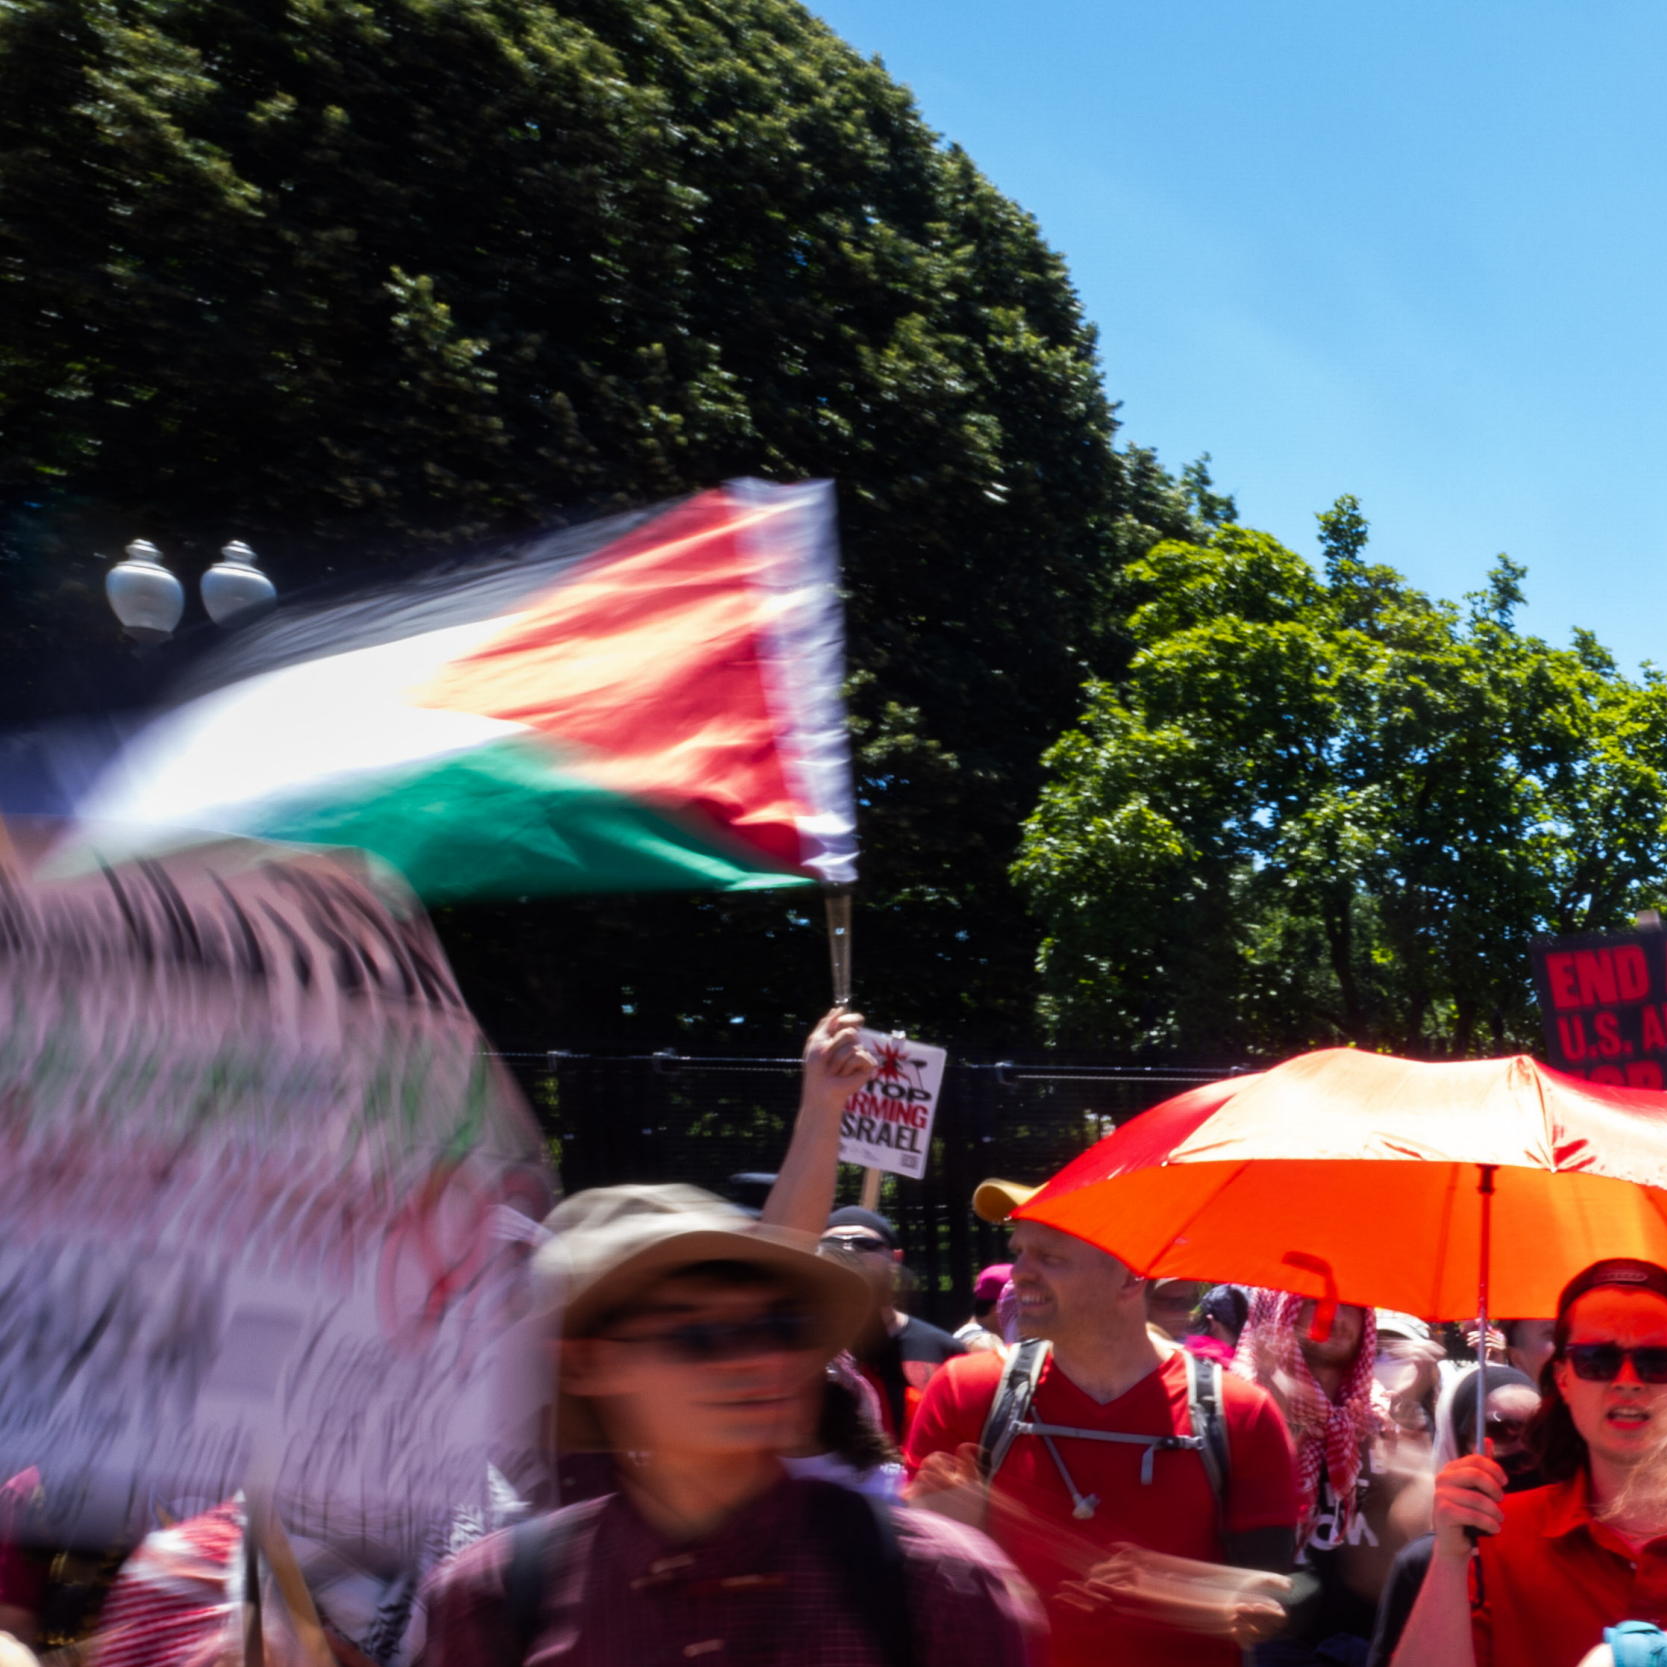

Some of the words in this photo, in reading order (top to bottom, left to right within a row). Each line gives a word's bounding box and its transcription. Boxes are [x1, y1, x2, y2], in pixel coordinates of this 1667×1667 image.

[1545, 946, 1651, 1011] END
[1556, 1013, 1634, 1061] U.S.
[866, 1079, 932, 1103] TOP
[841, 1112, 922, 1154] SRAEL
